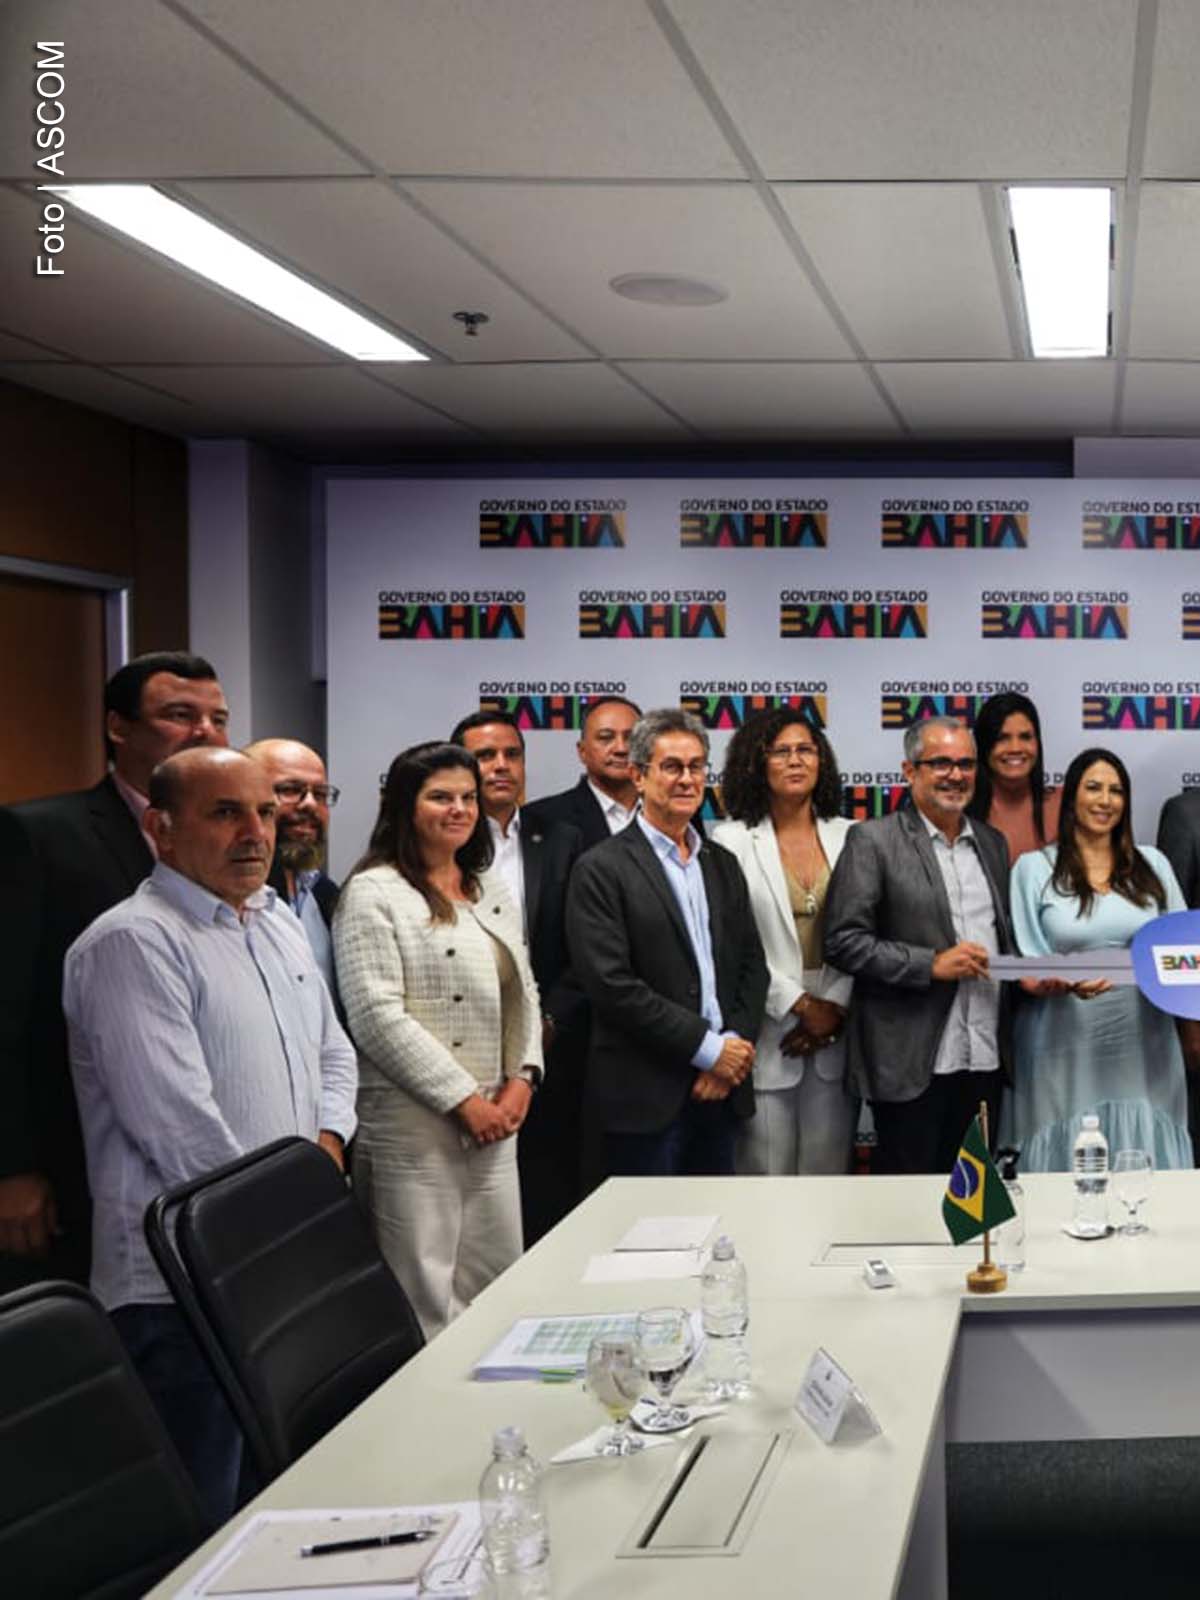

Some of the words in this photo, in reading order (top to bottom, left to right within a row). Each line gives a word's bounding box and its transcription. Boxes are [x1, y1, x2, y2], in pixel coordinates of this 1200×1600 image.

[479, 499, 547, 512] GOVERNO
[550, 499, 570, 512] DO
[574, 499, 625, 512] ESTADO
[680, 499, 748, 512] GOVERNO
[752, 499, 772, 512] DO
[776, 499, 828, 512] ESTADO
[881, 499, 949, 512] GOVERNO
[953, 499, 973, 512] DO
[977, 499, 1029, 512] ESTADO
[1081, 501, 1149, 514] GOVERNO
[1153, 501, 1173, 514] DO
[479, 512, 625, 548] BAHIA
[680, 512, 828, 547] BAHIA
[881, 512, 1029, 548] BAHIA
[378, 590, 446, 603] GOVERNO
[450, 590, 470, 603] DO
[474, 590, 526, 603] ESTADO
[578, 590, 647, 603] GOVERNO
[650, 590, 670, 603] DO
[675, 590, 727, 603] ESTADO
[779, 590, 848, 603] GOVERNO
[851, 590, 871, 603] DO
[876, 590, 928, 603] ESTADO
[981, 590, 1049, 603] GOVERNO
[1053, 590, 1073, 603] DO
[1077, 590, 1129, 603] ESTADO
[378, 603, 526, 639] BAHIA
[578, 603, 727, 639] BAHIA
[779, 603, 928, 639] BAHIA
[981, 603, 1129, 639] BAHIA
[479, 681, 547, 694] GOVERNO
[550, 681, 570, 694] DO
[574, 681, 626, 694] ESTADO
[679, 681, 748, 694] GOVERNO
[751, 681, 771, 694] DO
[776, 681, 828, 694] ESTADO
[881, 681, 949, 694] GOVERNO
[953, 681, 973, 694] DO
[1081, 681, 1149, 694] GOVERNO
[1153, 681, 1173, 694] DO
[852, 772, 873, 785] DO
[876, 772, 908, 785] ESTA
